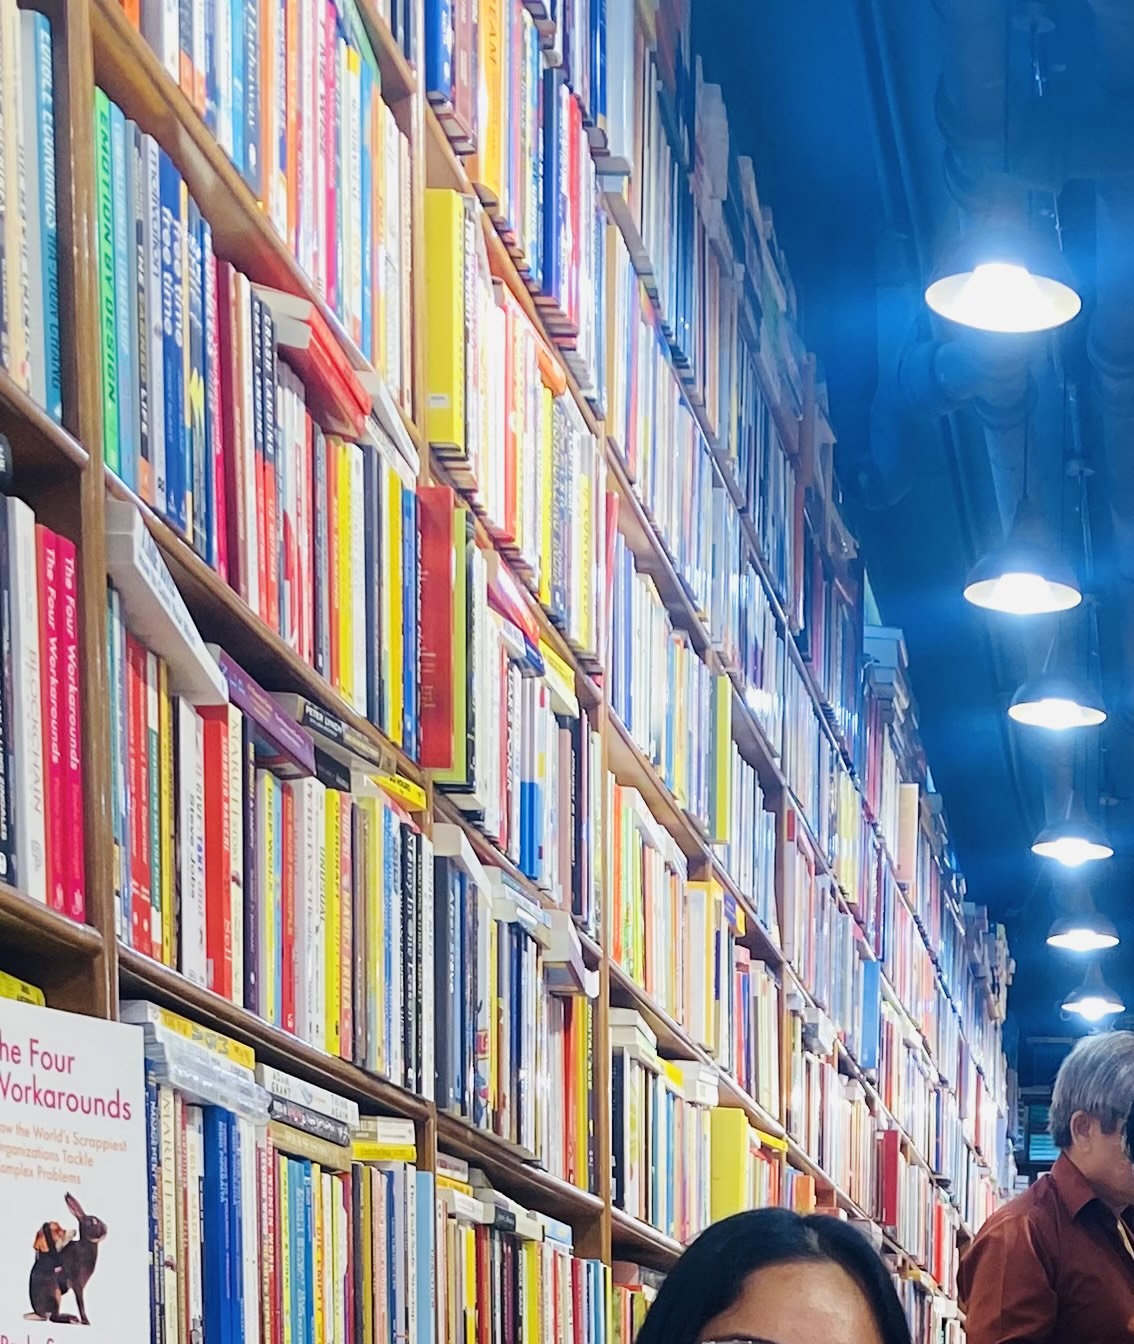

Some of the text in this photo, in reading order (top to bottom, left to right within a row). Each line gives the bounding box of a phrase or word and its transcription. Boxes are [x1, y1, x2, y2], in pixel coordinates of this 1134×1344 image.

[100, 111, 111, 242] EMOTION
[106, 301, 116, 403] DESIGN
[45, 548, 56, 581] The
[47, 586, 57, 630] Four
[64, 556, 78, 770] The Four Workarounds
[47, 636, 60, 764] Workarounds
[0, 1028, 75, 1074] he Four
[0, 1144, 94, 1166] rganizations Tackle
[16, 1122, 127, 1152] the World's Scrappiest
[0, 1164, 81, 1184] omplex Problems
